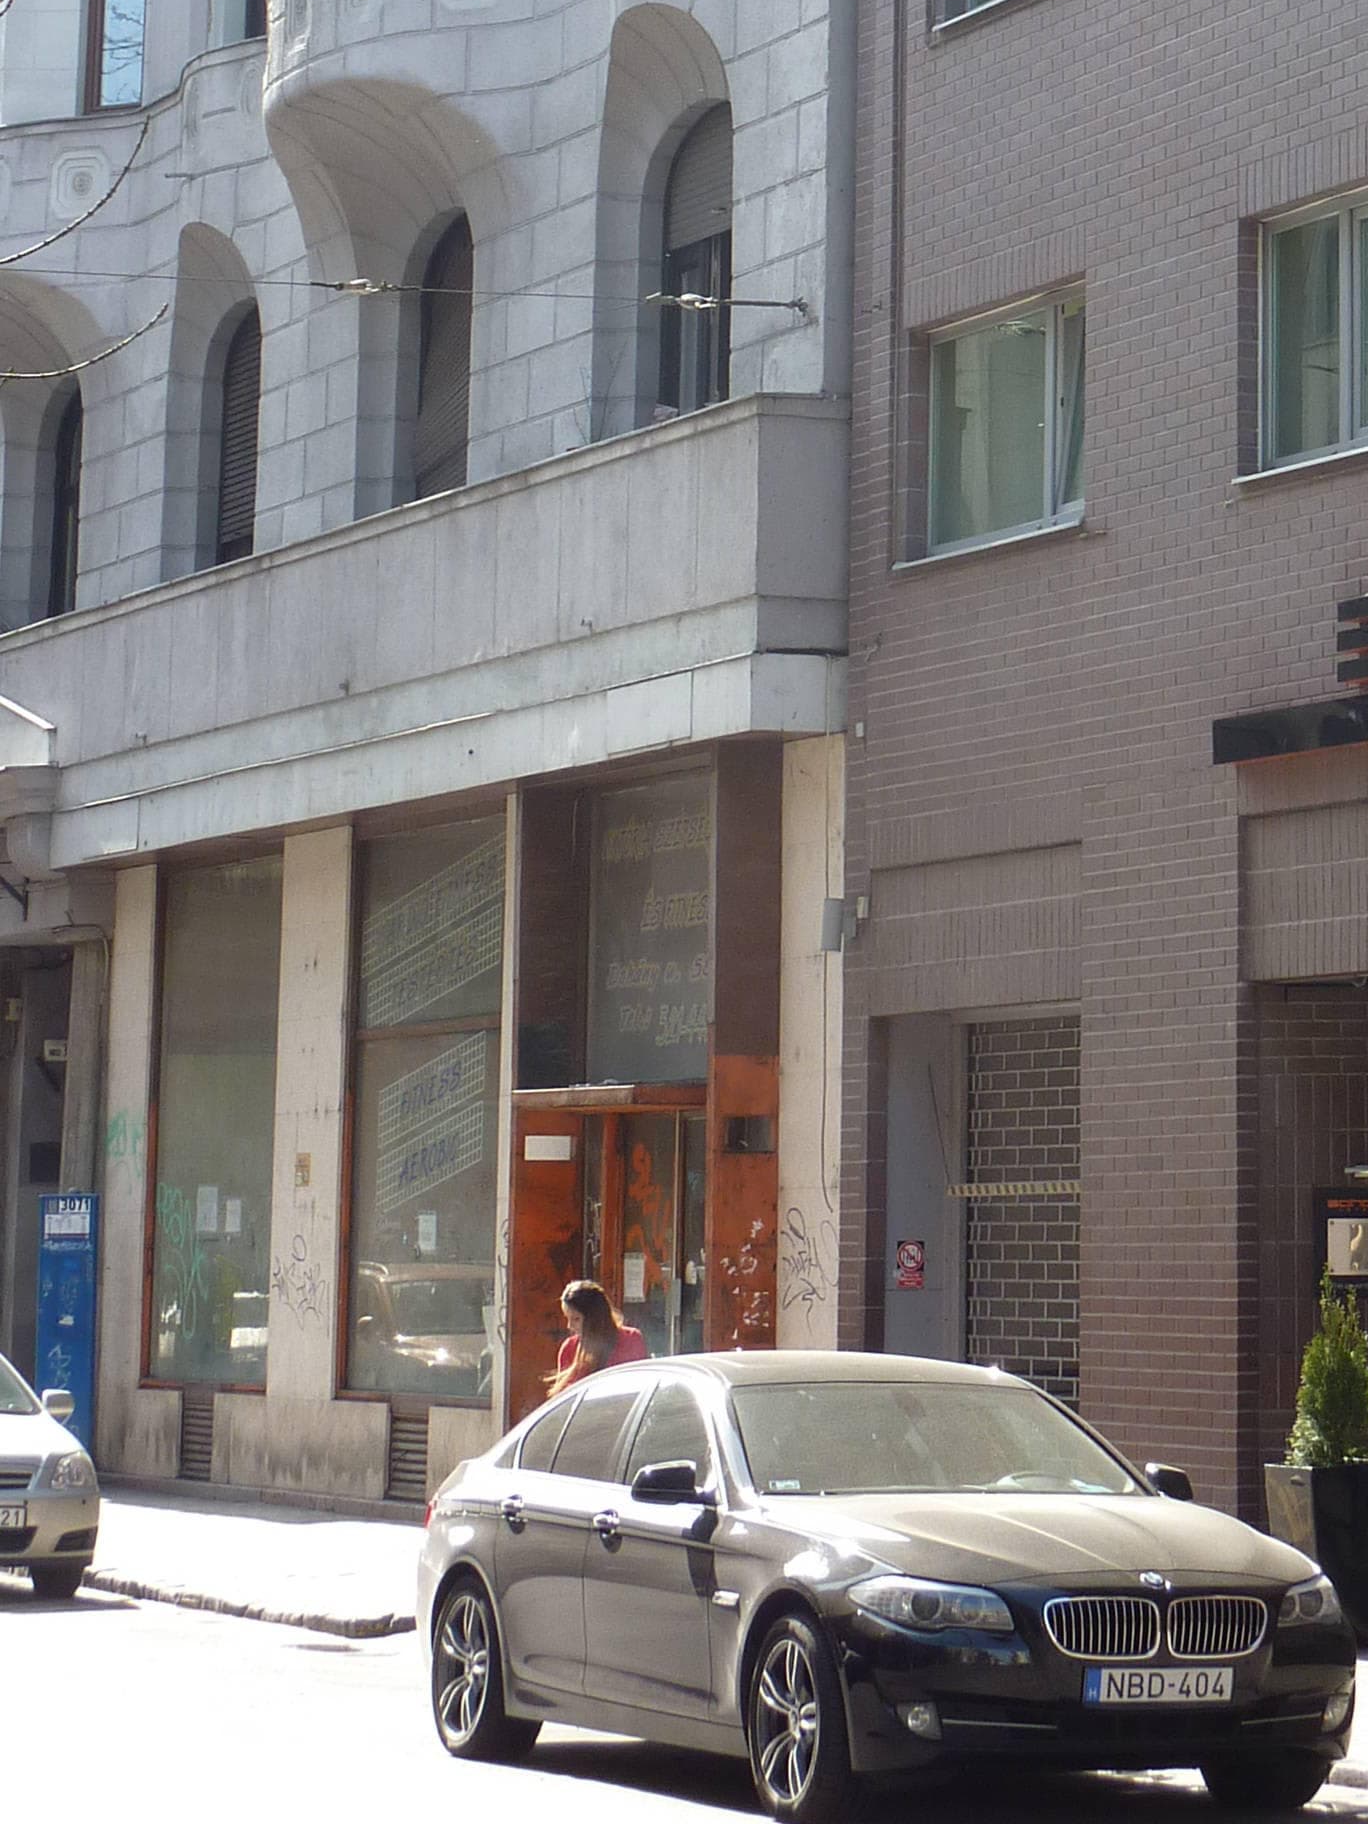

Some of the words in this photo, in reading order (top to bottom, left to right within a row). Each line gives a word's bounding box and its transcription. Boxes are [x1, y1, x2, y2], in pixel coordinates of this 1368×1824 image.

[399, 1058, 464, 1117] FITNESS
[61, 1198, 90, 1212] 3071
[1106, 1671, 1225, 1700] NBD-404
